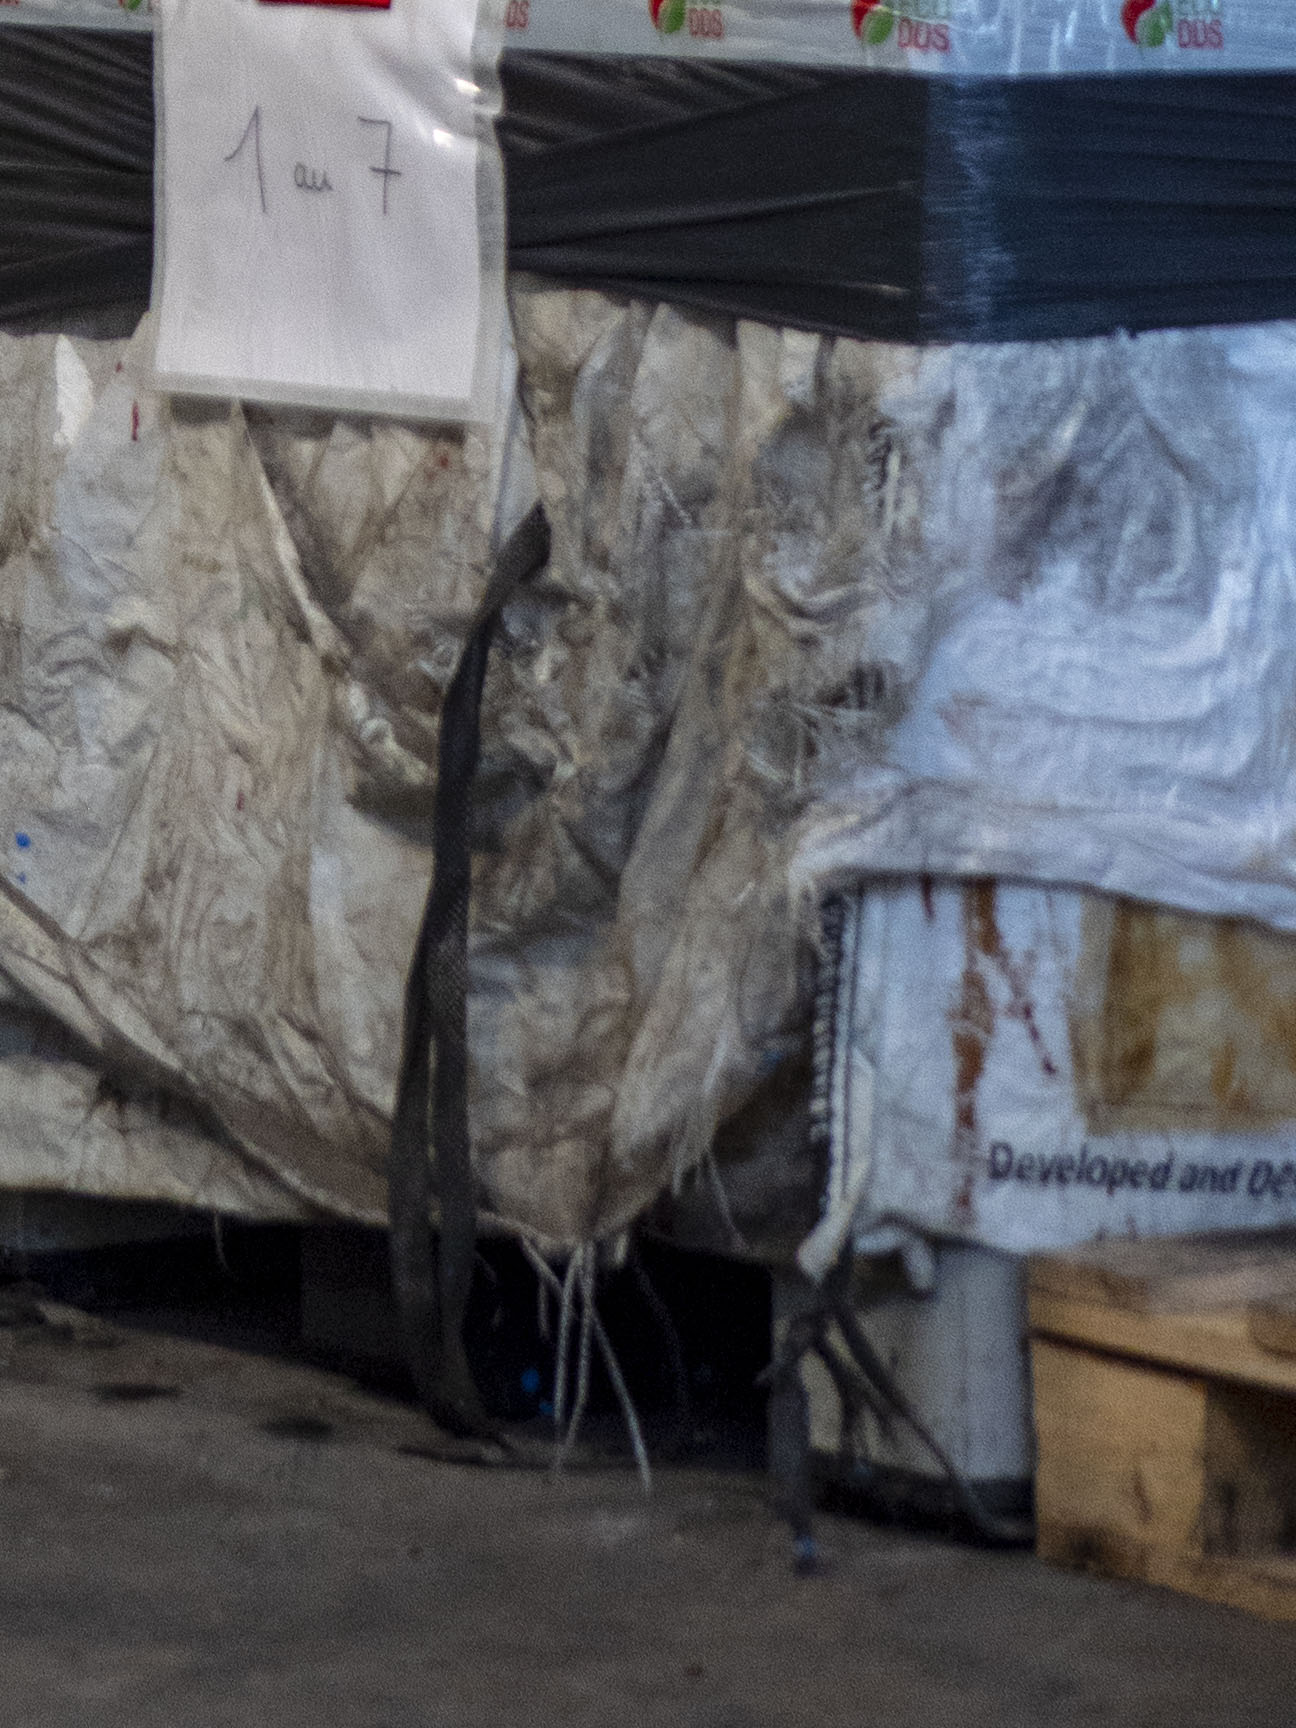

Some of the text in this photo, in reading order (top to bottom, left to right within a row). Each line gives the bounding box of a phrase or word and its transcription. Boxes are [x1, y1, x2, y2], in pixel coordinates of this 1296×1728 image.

[687, 7, 723, 38] DDS
[898, 18, 950, 52] DDS
[1176, 17, 1223, 49] DDS
[224, 106, 401, 215] 1 au 7
[988, 1141, 1173, 1197] Developed
[1179, 1158, 1243, 1192] and
